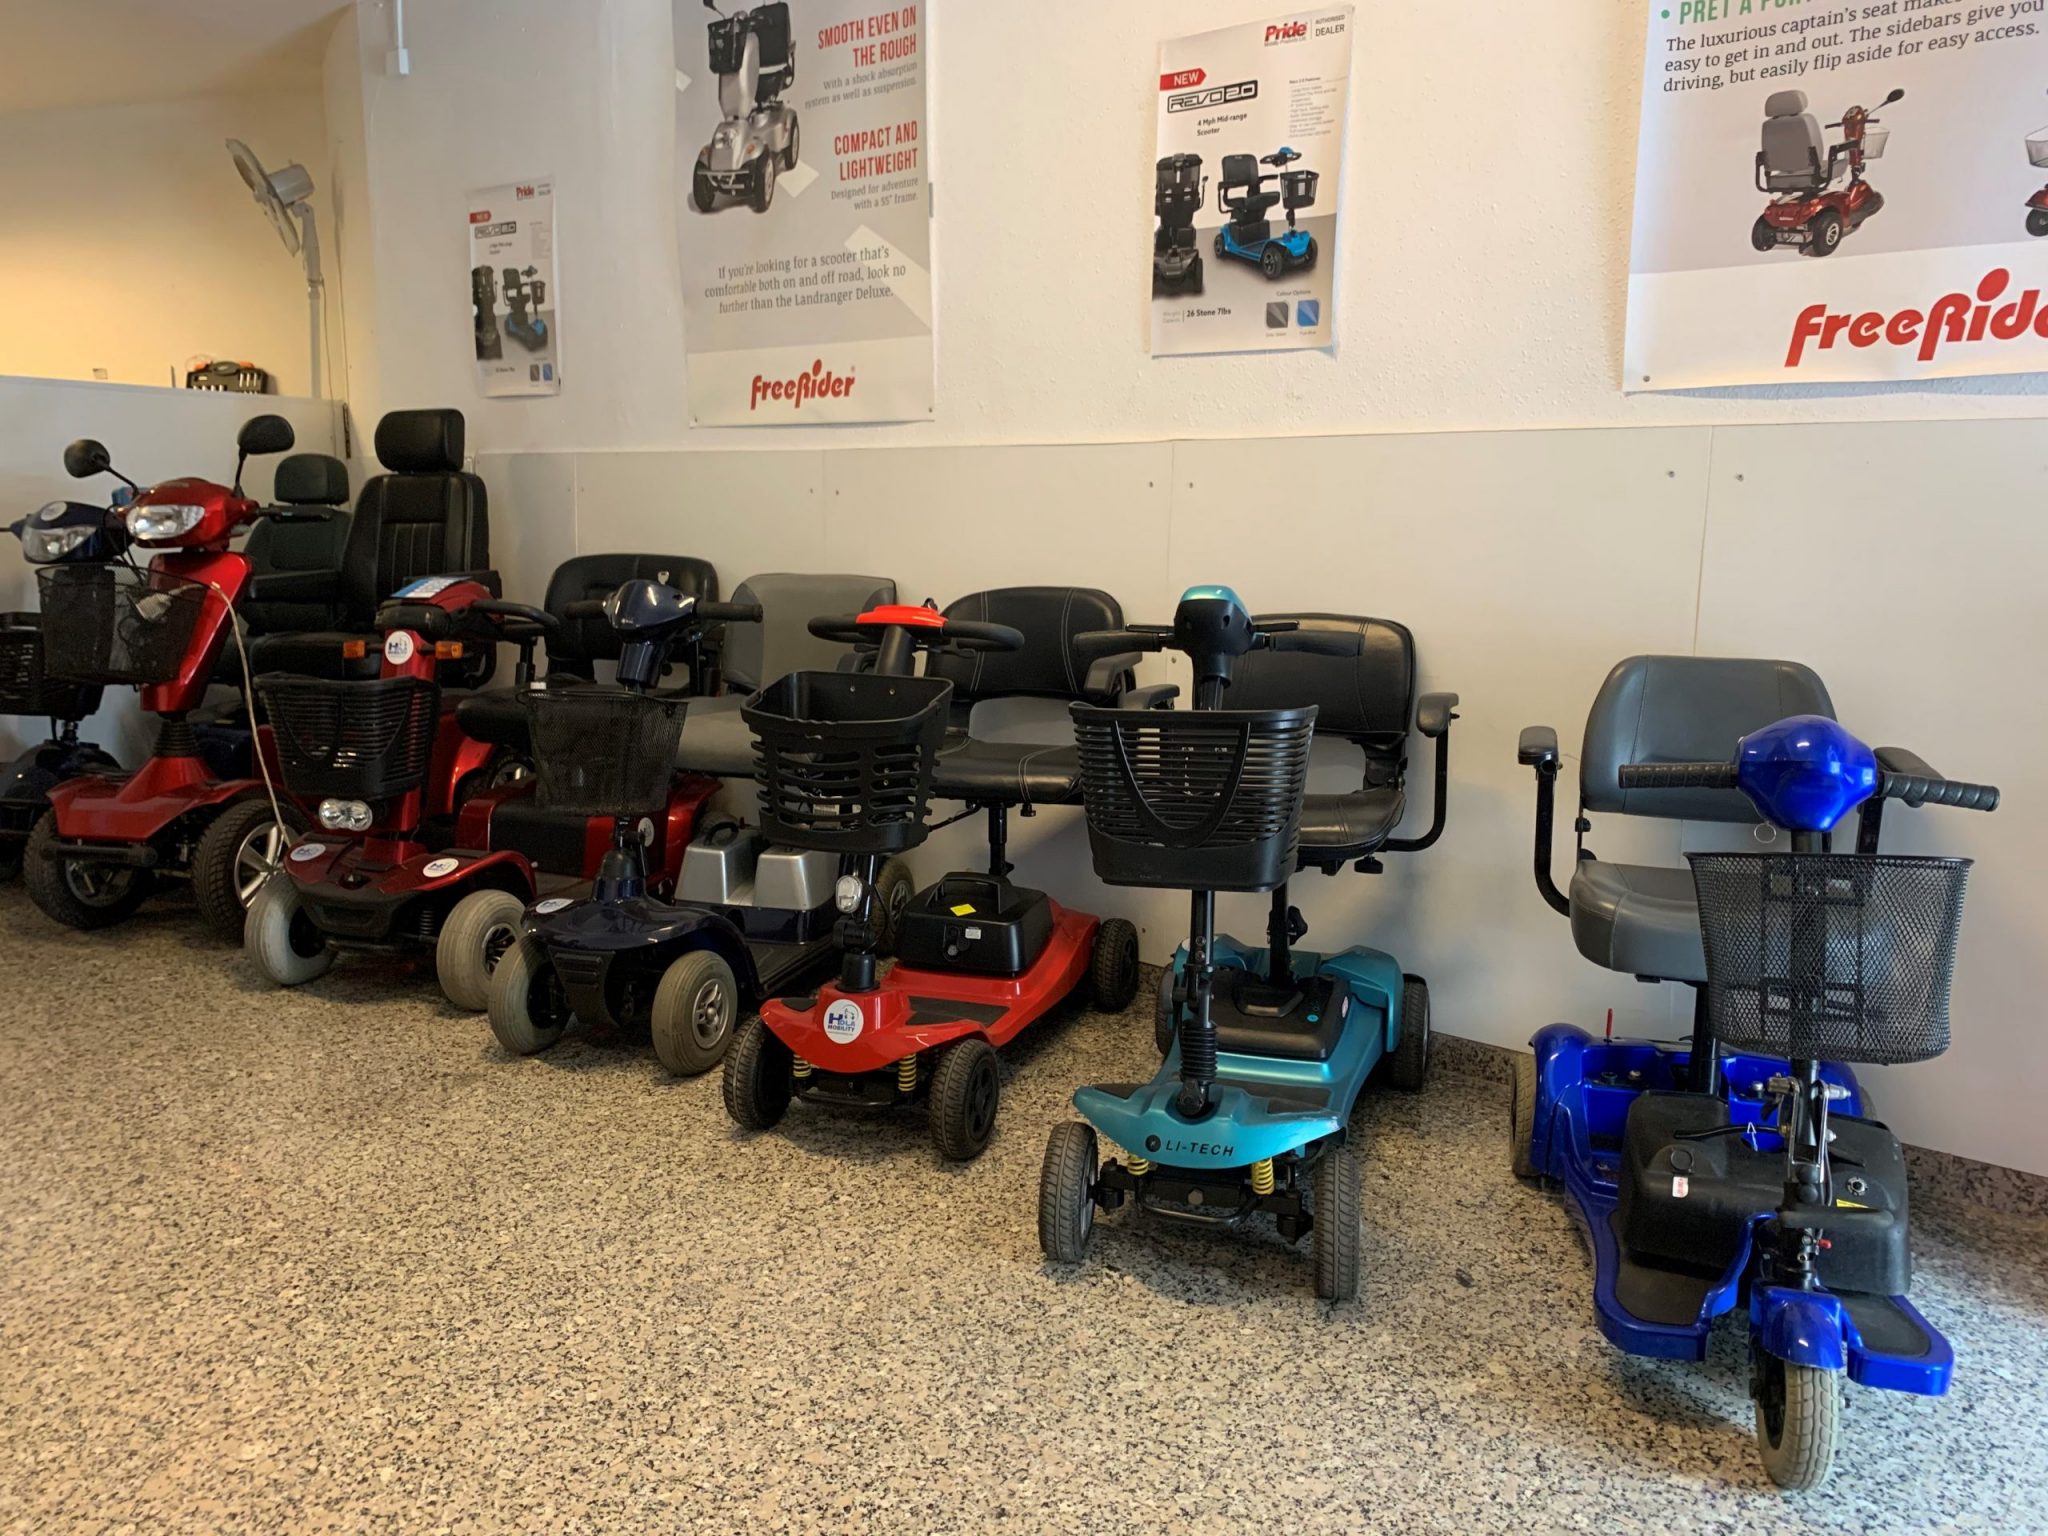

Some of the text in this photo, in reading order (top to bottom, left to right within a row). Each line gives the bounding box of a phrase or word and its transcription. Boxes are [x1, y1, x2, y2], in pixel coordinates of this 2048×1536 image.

[818, 5, 917, 50] SMOOTH EVEN ON
[1265, 21, 1307, 42] Pride
[1315, 24, 1345, 37] DEALER
[1665, 56, 1701, 73] easy
[1705, 54, 1721, 68] to
[1725, 49, 1749, 68] get
[1753, 42, 1770, 59] in
[1775, 37, 1806, 56] and
[1811, 32, 1844, 50] out.
[1849, 26, 1882, 43] The
[1886, 11, 1962, 37] sidebars
[1966, 5, 2005, 26] give
[2009, 0, 2044, 19] you
[1666, 36, 1696, 51] The
[1700, 24, 1777, 48] luxurious
[1781, 8, 1857, 34] captain's
[1862, 1, 1898, 19] seat
[853, 33, 917, 68] THE ROUGH
[1663, 22, 2040, 92] driving, but easily flip aside for easy access.
[823, 62, 917, 90] With a shock absorption
[1174, 71, 1200, 87] NEW
[804, 96, 830, 110] system
[832, 94, 841, 103] as
[843, 88, 860, 100] well
[862, 88, 871, 97] as
[1170, 90, 1223, 110] REVO
[834, 120, 918, 156] COMPACT AND
[1196, 128, 1220, 136] Scooter
[840, 148, 918, 181] LIGHTWEIGHT
[831, 177, 918, 200] Designed for adventure
[854, 199, 872, 210] with
[718, 245, 890, 281] If you're looking for a scooter that's
[705, 264, 906, 298] comfortable both on and off road, look no
[719, 284, 894, 314] further than the Landranger Deluxe.
[1187, 309, 1195, 318] 26
[1196, 308, 1216, 317] Stone
[1165, 1139, 1234, 1157] LI-TECH
